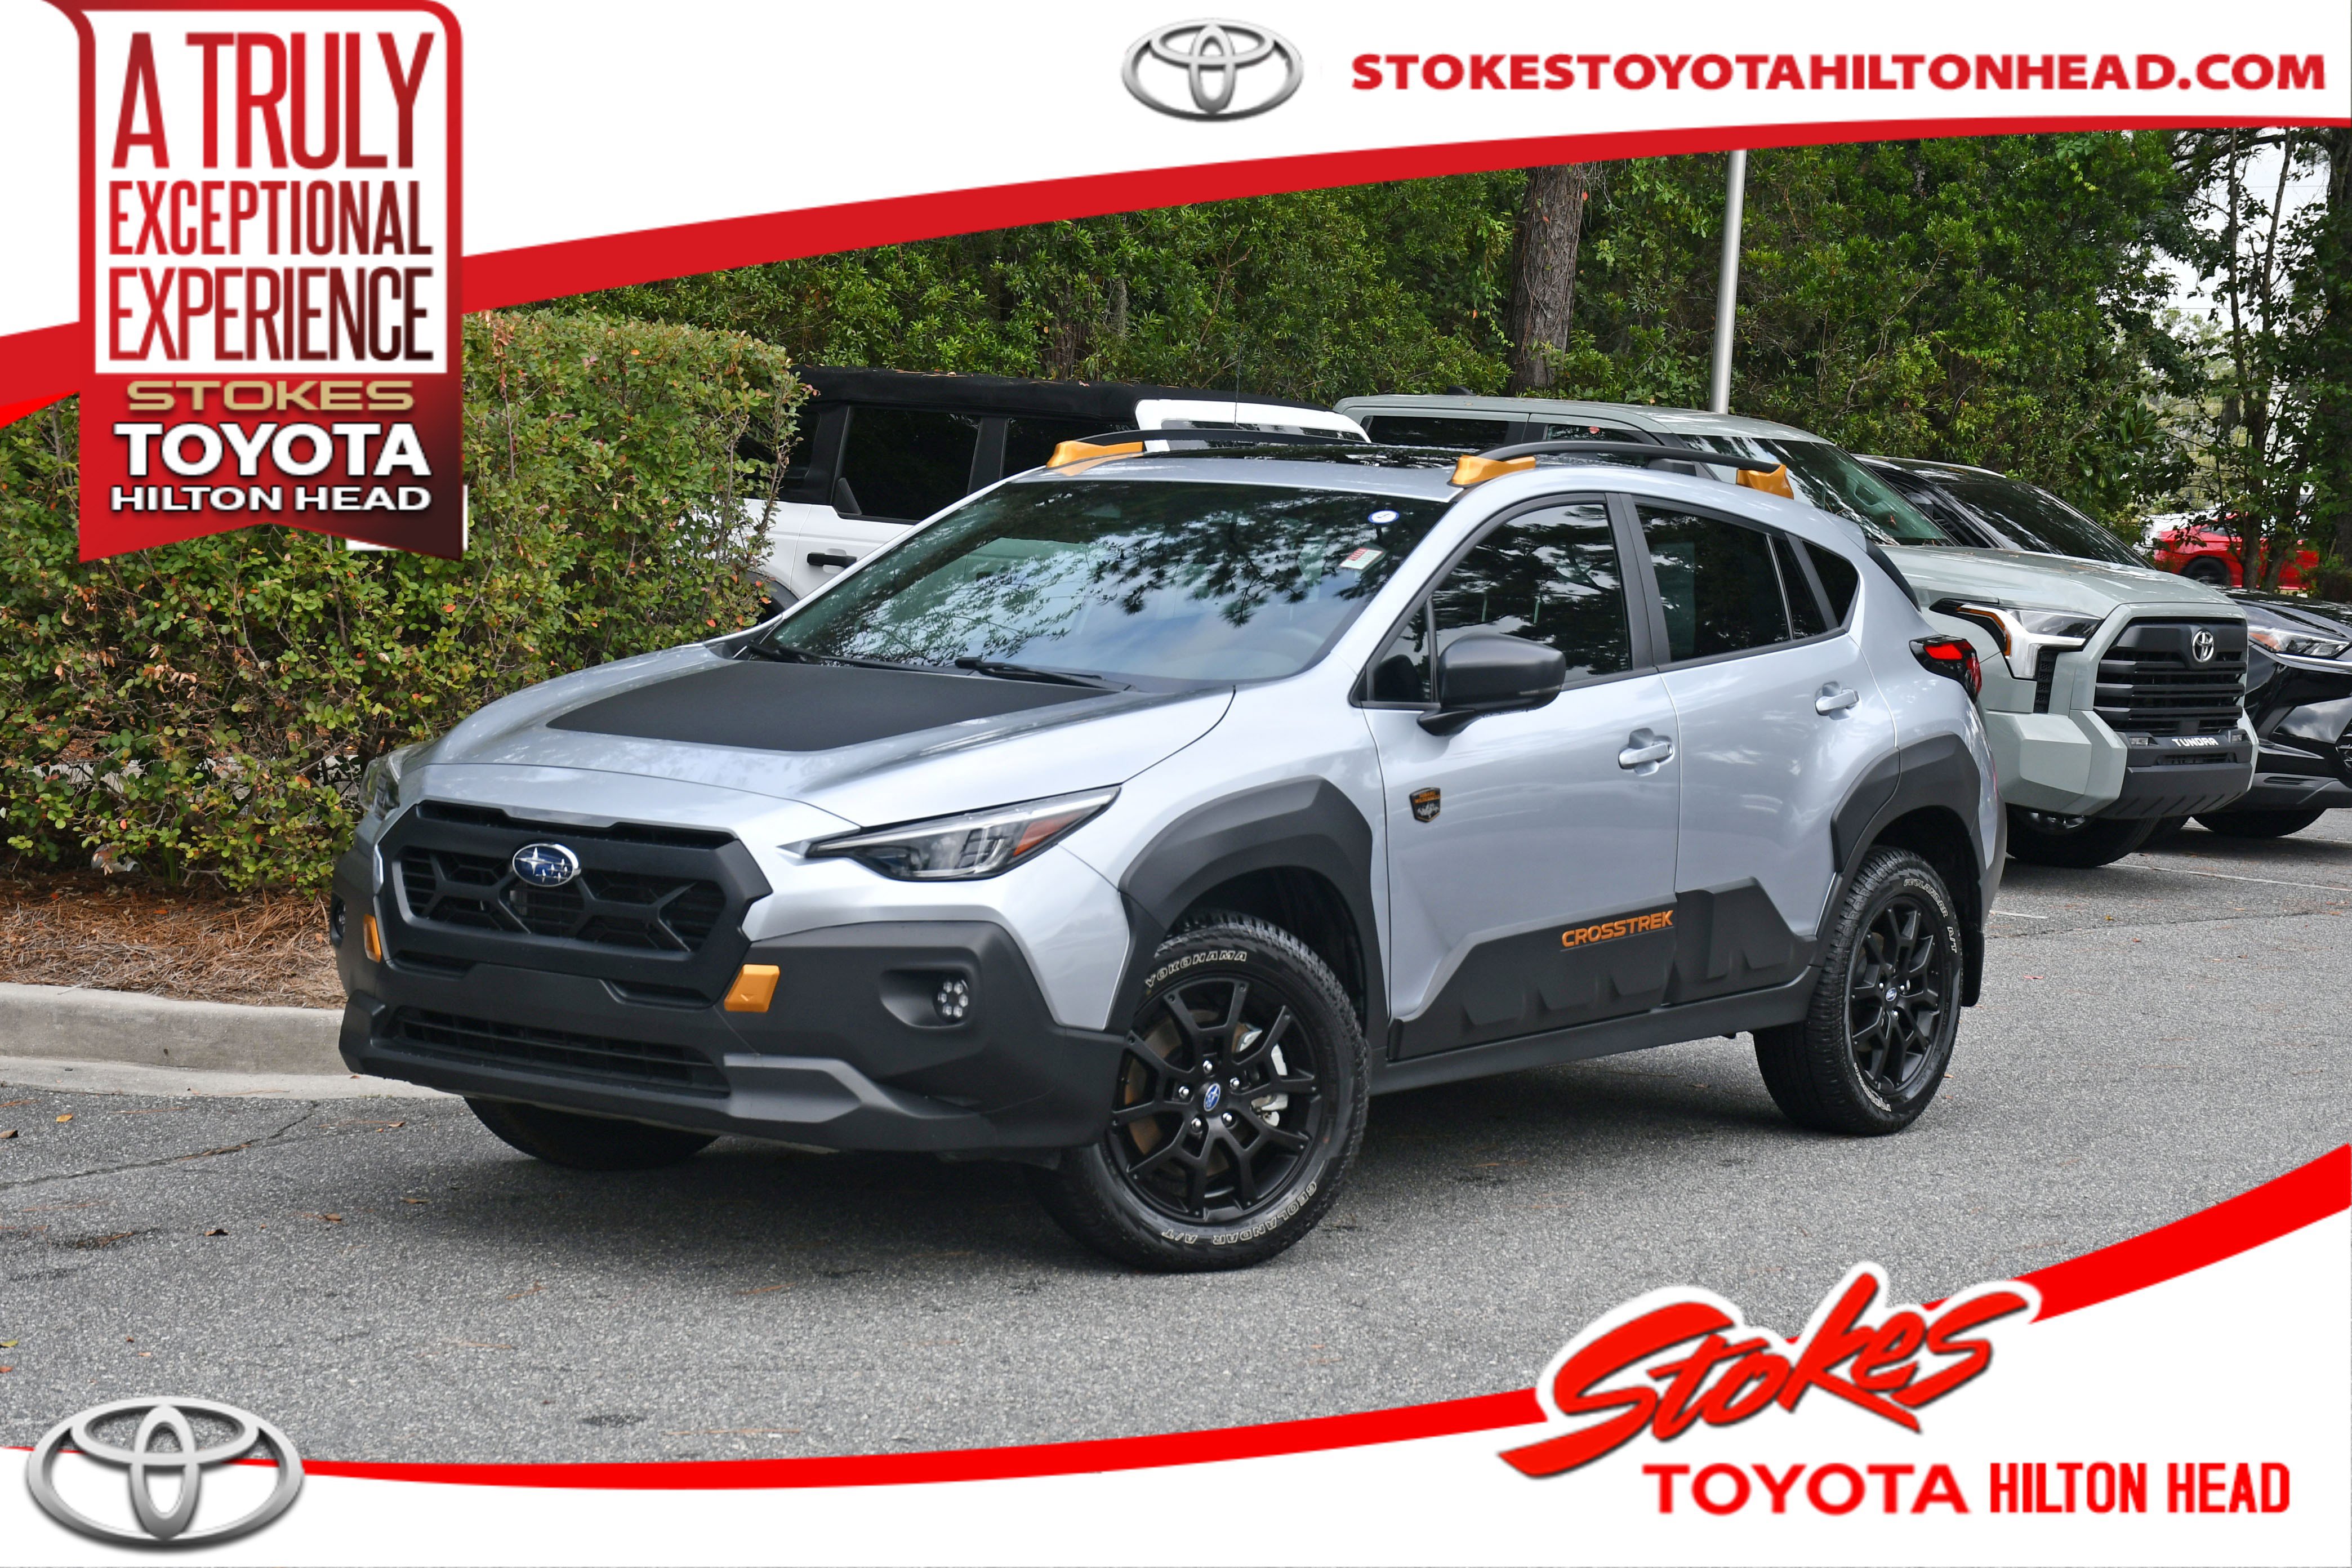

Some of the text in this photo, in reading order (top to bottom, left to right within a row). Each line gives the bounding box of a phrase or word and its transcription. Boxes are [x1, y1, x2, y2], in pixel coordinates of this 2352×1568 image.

[2171, 737, 2219, 747] TUNDRA
[1562, 910, 1673, 947] CROSSTREK
[1946, 926, 1957, 953] A/T
[1145, 950, 1247, 988] YOKOHAMA
[1161, 1181, 1317, 1245] GEOLANDAR A/T
